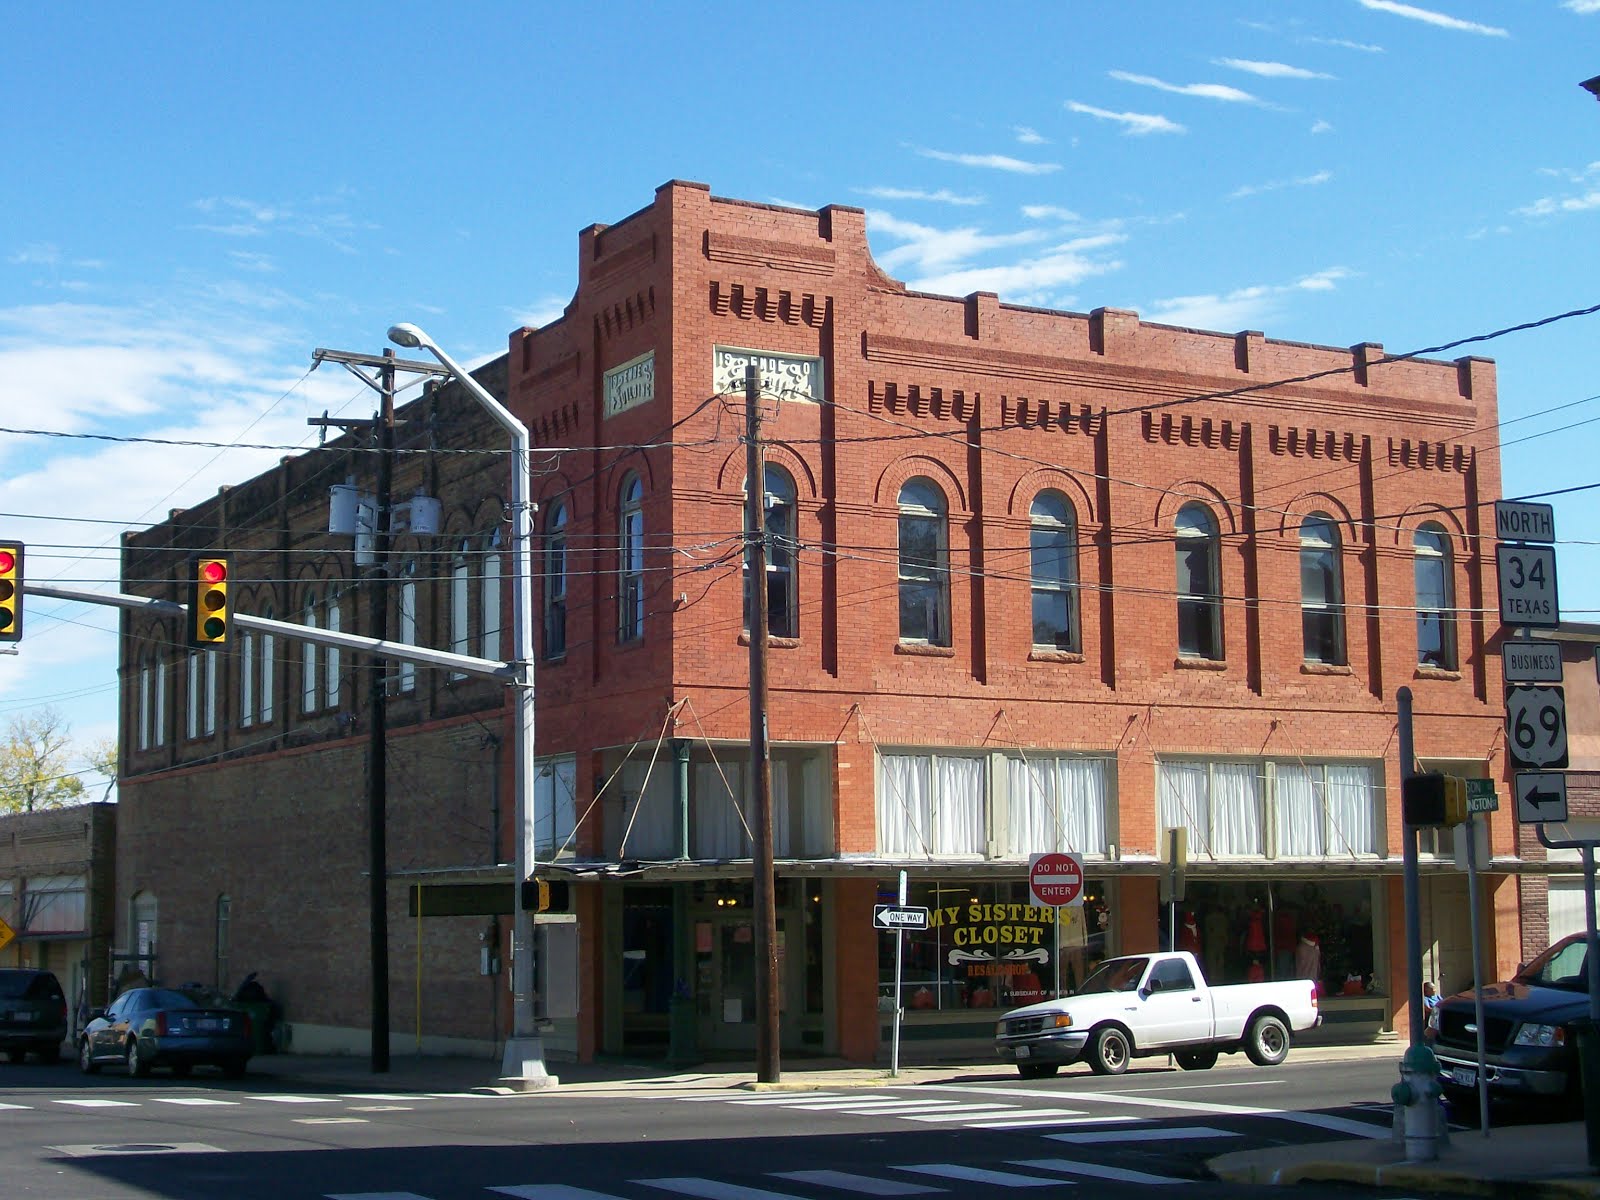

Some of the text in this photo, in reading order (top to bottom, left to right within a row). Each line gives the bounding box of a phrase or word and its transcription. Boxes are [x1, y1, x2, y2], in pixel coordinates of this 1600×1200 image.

[1500, 510, 1550, 534] NORTH
[1509, 556, 1546, 590] 34
[1508, 598, 1550, 615] TEXAS
[1511, 654, 1555, 671] BUSINESS
[1514, 705, 1561, 750] 69
[1037, 863, 1074, 873] DO NOT
[1041, 887, 1071, 896] ENTER
[890, 912, 922, 922] ONE WAY
[928, 906, 960, 928] MY
[953, 925, 1044, 946] CLOSET
